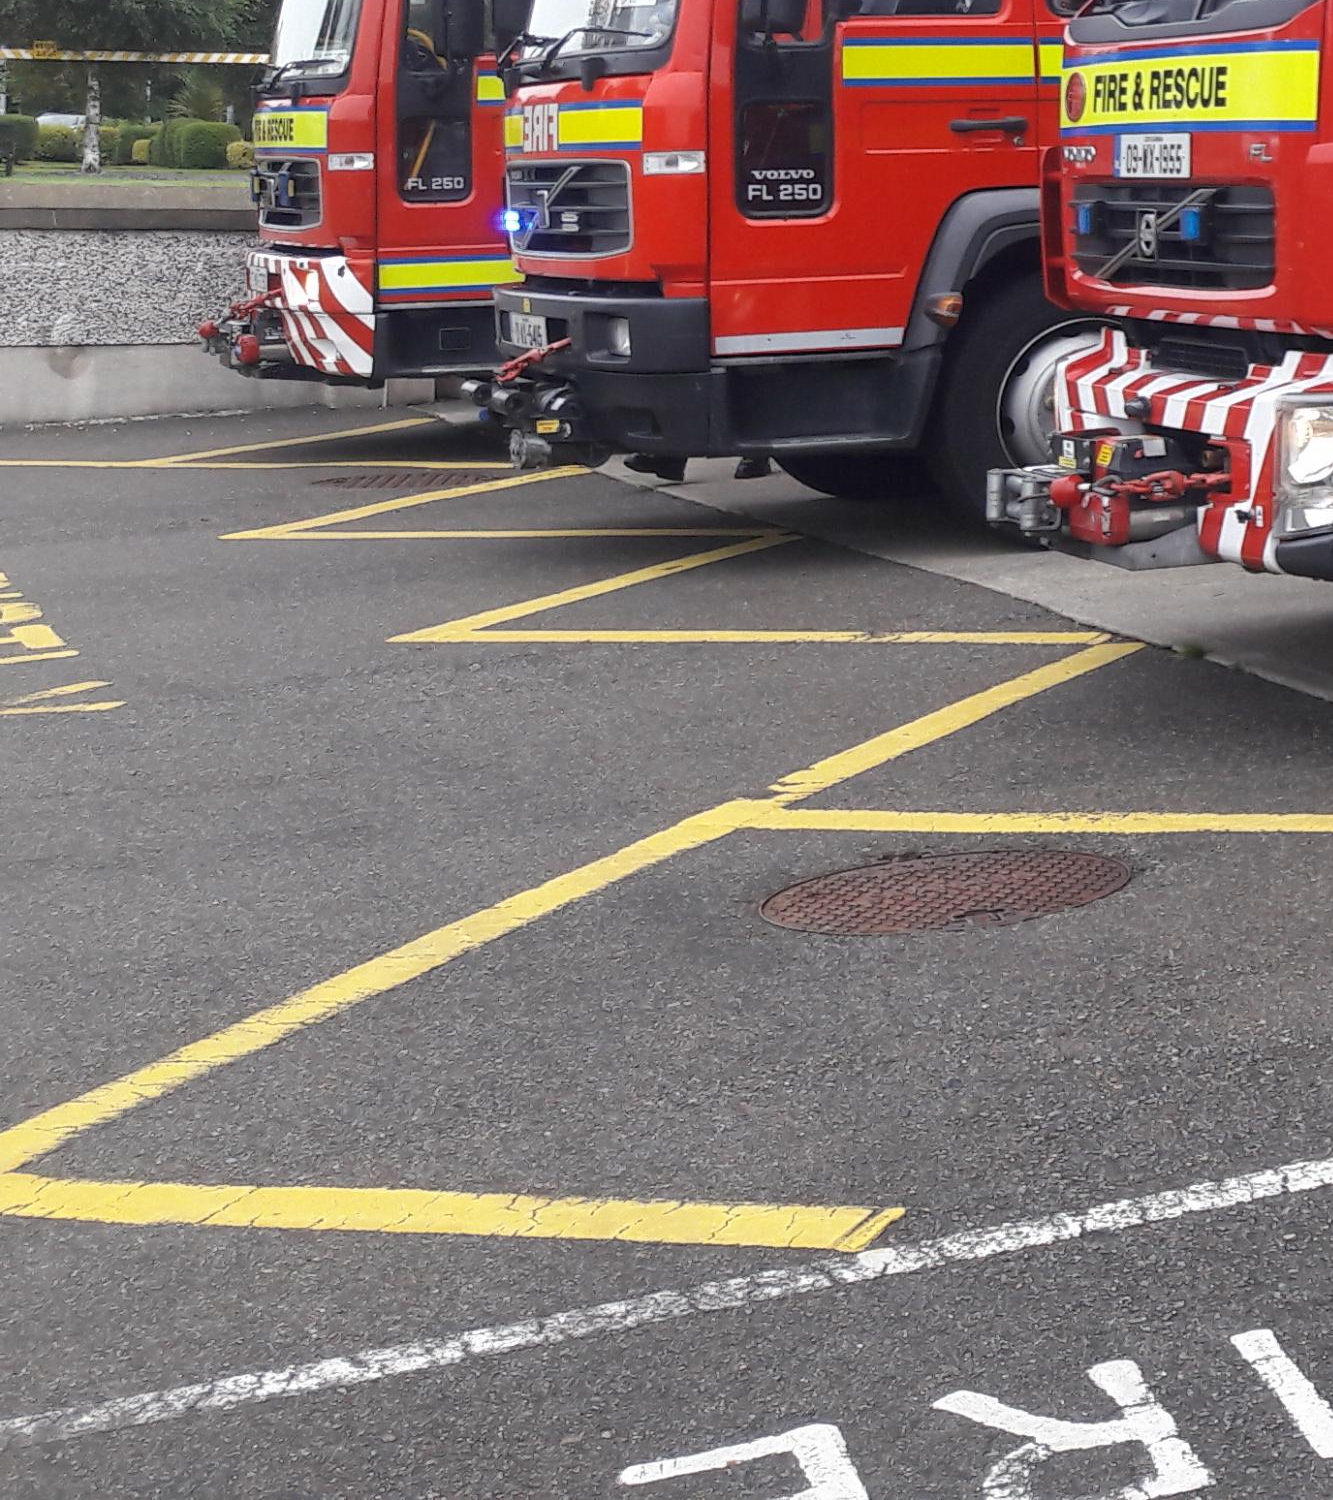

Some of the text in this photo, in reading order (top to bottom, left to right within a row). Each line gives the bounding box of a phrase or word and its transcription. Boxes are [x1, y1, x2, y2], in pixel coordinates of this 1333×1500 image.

[1093, 66, 1228, 113] FIRE & RESCUE
[751, 169, 815, 180] VOLVO
[407, 177, 464, 190] FL 250
[748, 184, 822, 201] FL 250
